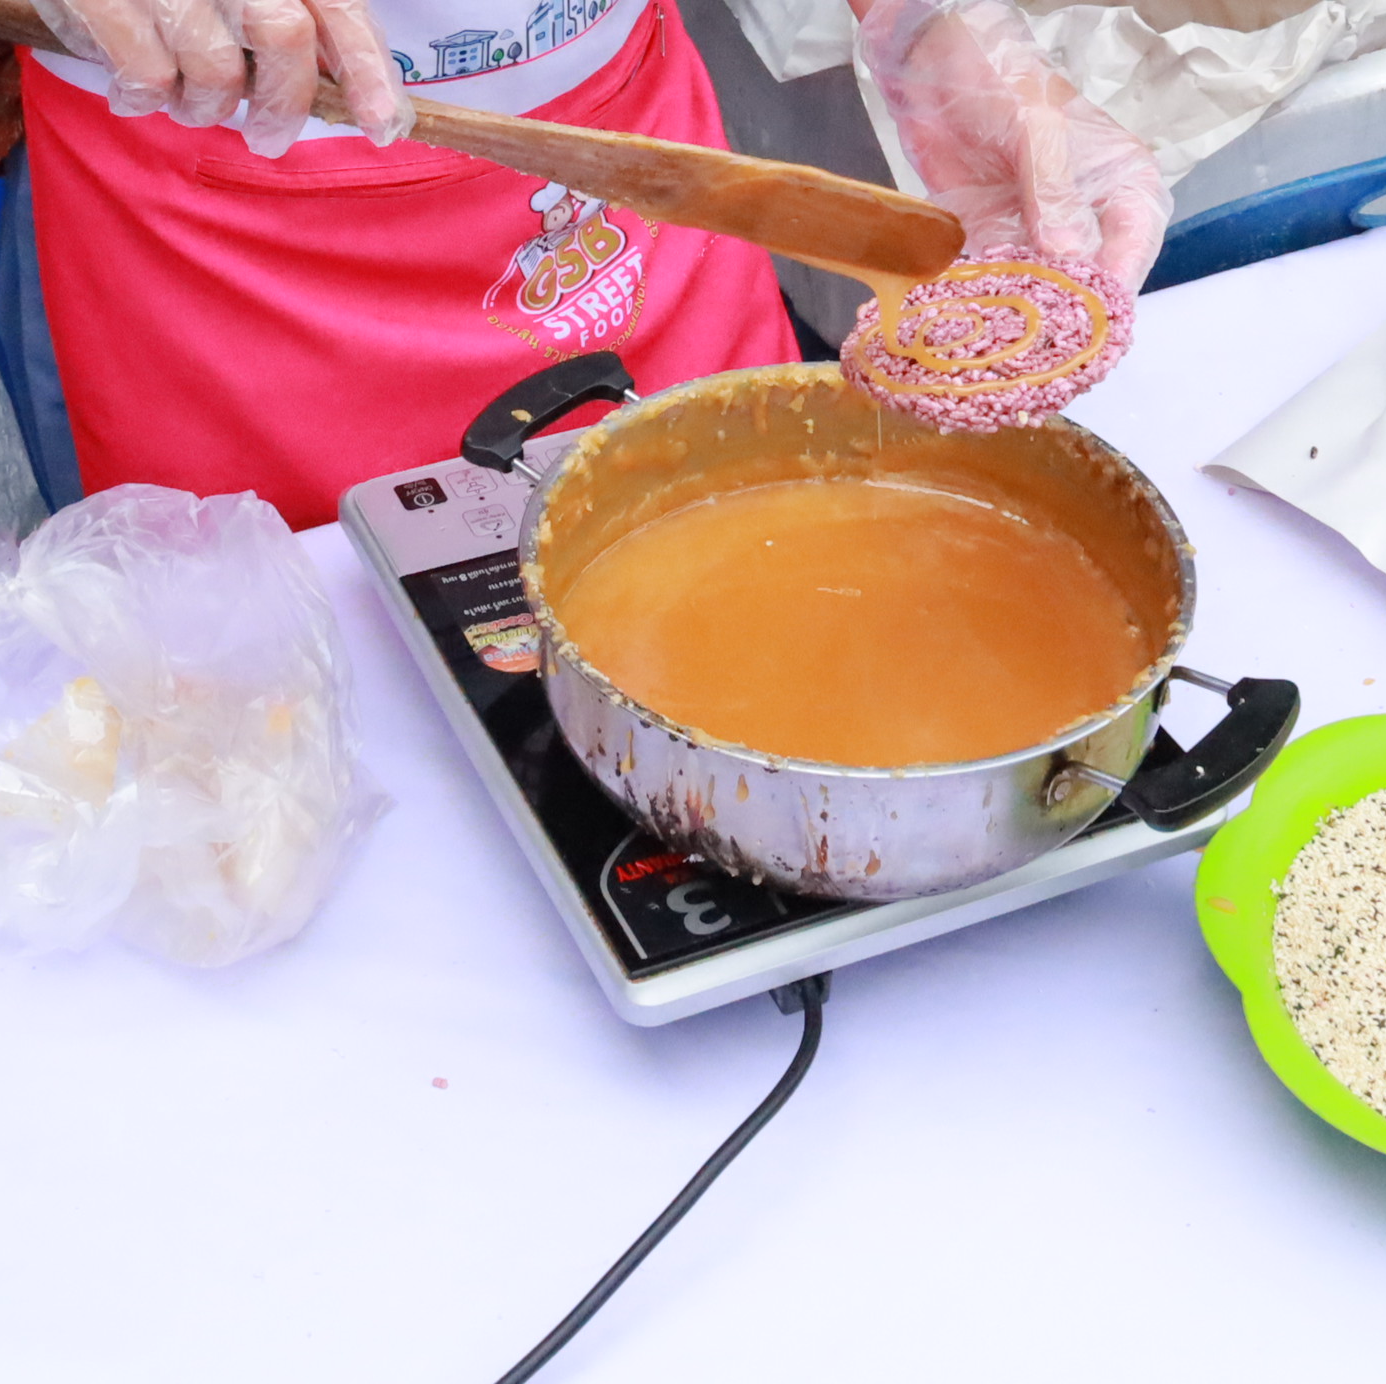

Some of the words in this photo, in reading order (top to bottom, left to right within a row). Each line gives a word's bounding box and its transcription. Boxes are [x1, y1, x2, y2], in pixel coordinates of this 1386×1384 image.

[516, 213, 625, 315] GSB
[542, 252, 643, 340] STREET
[579, 296, 633, 348] FOOD
[486, 314, 540, 350] ออมสิน
[666, 879, 732, 936] 3
